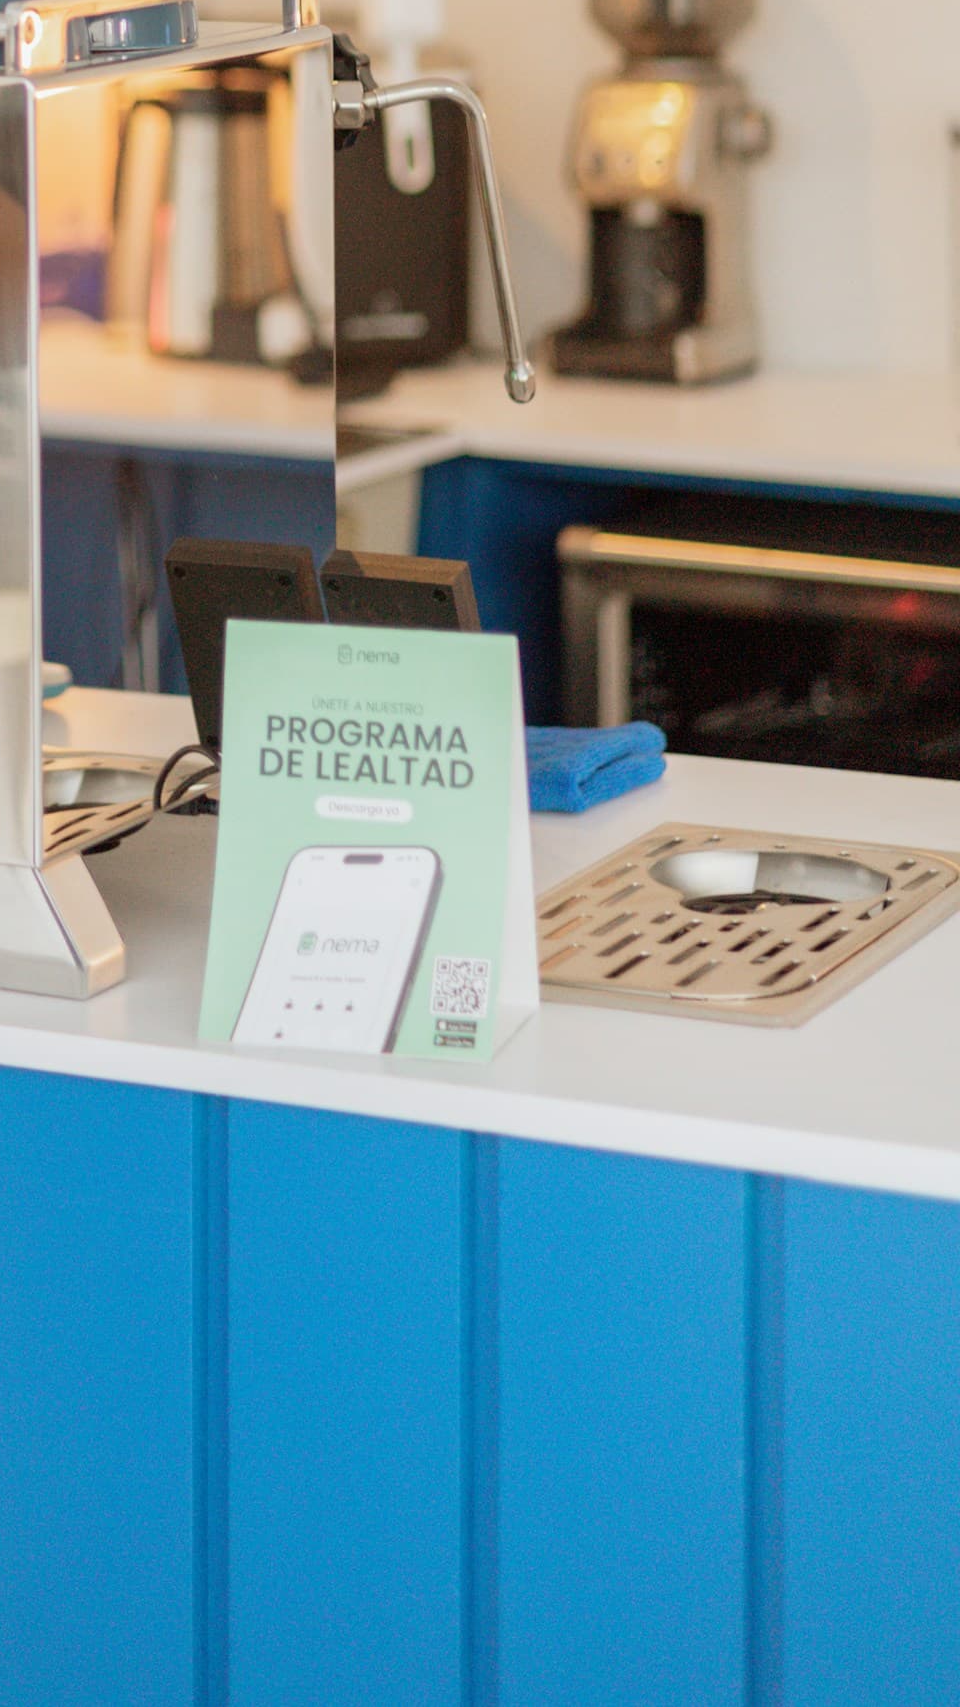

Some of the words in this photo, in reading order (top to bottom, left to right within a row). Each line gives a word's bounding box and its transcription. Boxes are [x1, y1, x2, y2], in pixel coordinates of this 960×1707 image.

[356, 649, 401, 665] nema
[353, 700, 363, 712] A
[366, 701, 425, 717] NUESTRO
[266, 714, 469, 754] PROGRAMA
[258, 747, 304, 778] DE
[315, 750, 474, 789] LEALTAD
[321, 937, 381, 955] nema
